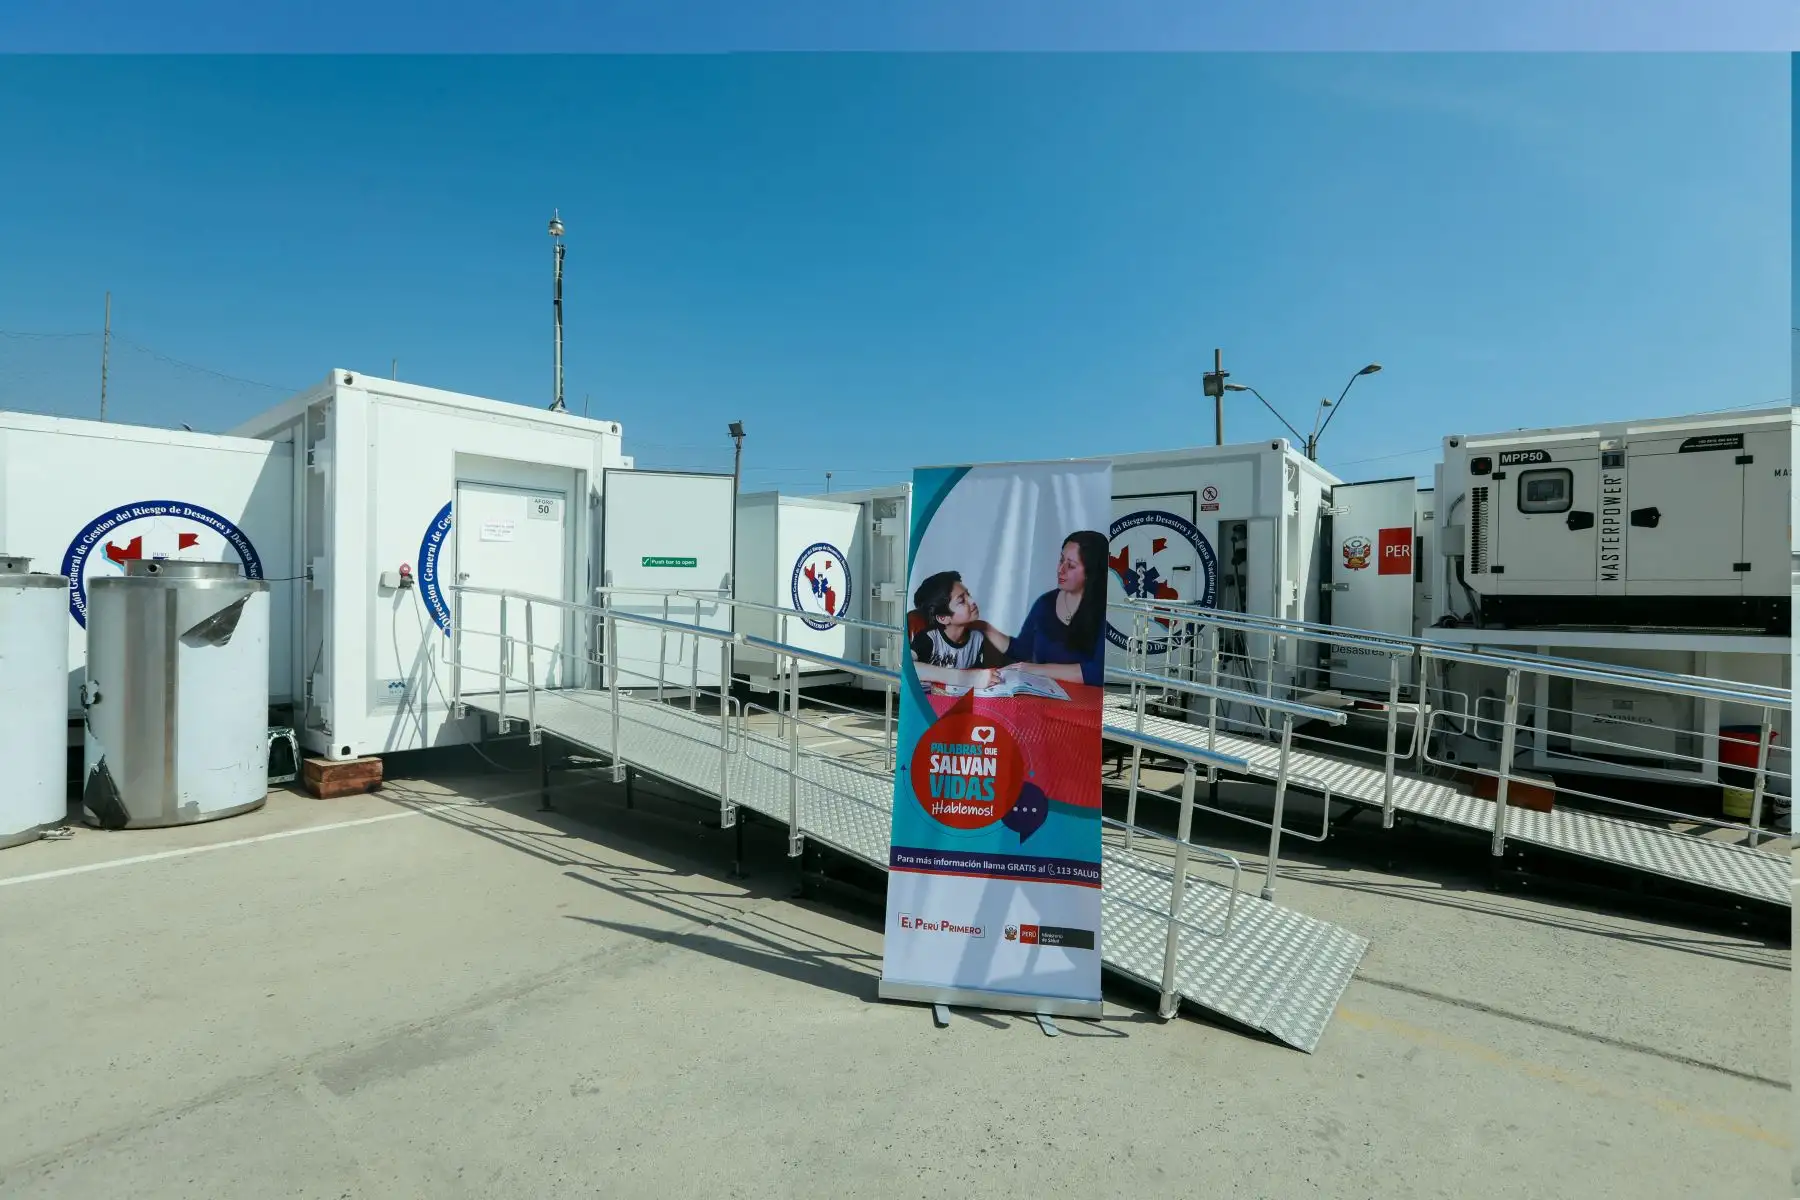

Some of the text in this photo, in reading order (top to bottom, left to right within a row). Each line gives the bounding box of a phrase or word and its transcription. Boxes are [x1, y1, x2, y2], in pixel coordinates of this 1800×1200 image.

[1501, 452, 1544, 464] MPP50
[538, 504, 549, 514] 50
[70, 556, 82, 590] General
[76, 543, 88, 555] de
[83, 519, 116, 544] Gestion
[115, 510, 131, 522] del
[132, 506, 166, 518] Riesgo
[169, 505, 181, 514] de
[184, 507, 226, 531] Desastres
[223, 527, 232, 535] y
[231, 532, 253, 561] Defensa
[423, 543, 437, 582] General
[431, 530, 442, 543] de
[1122, 517, 1144, 527] Riesgo
[1156, 515, 1187, 533] Desastres
[1191, 533, 1210, 560] Defensa
[1207, 560, 1217, 596] Nacional
[1385, 545, 1412, 557] PER
[930, 742, 998, 756] PALABRAS QUE
[930, 754, 997, 777] SALVAN
[929, 773, 995, 802] VIDAS
[932, 800, 994, 817] ¡Hablemos!
[897, 854, 1099, 879] Para más información llama GRATIS al 113 SALUD
